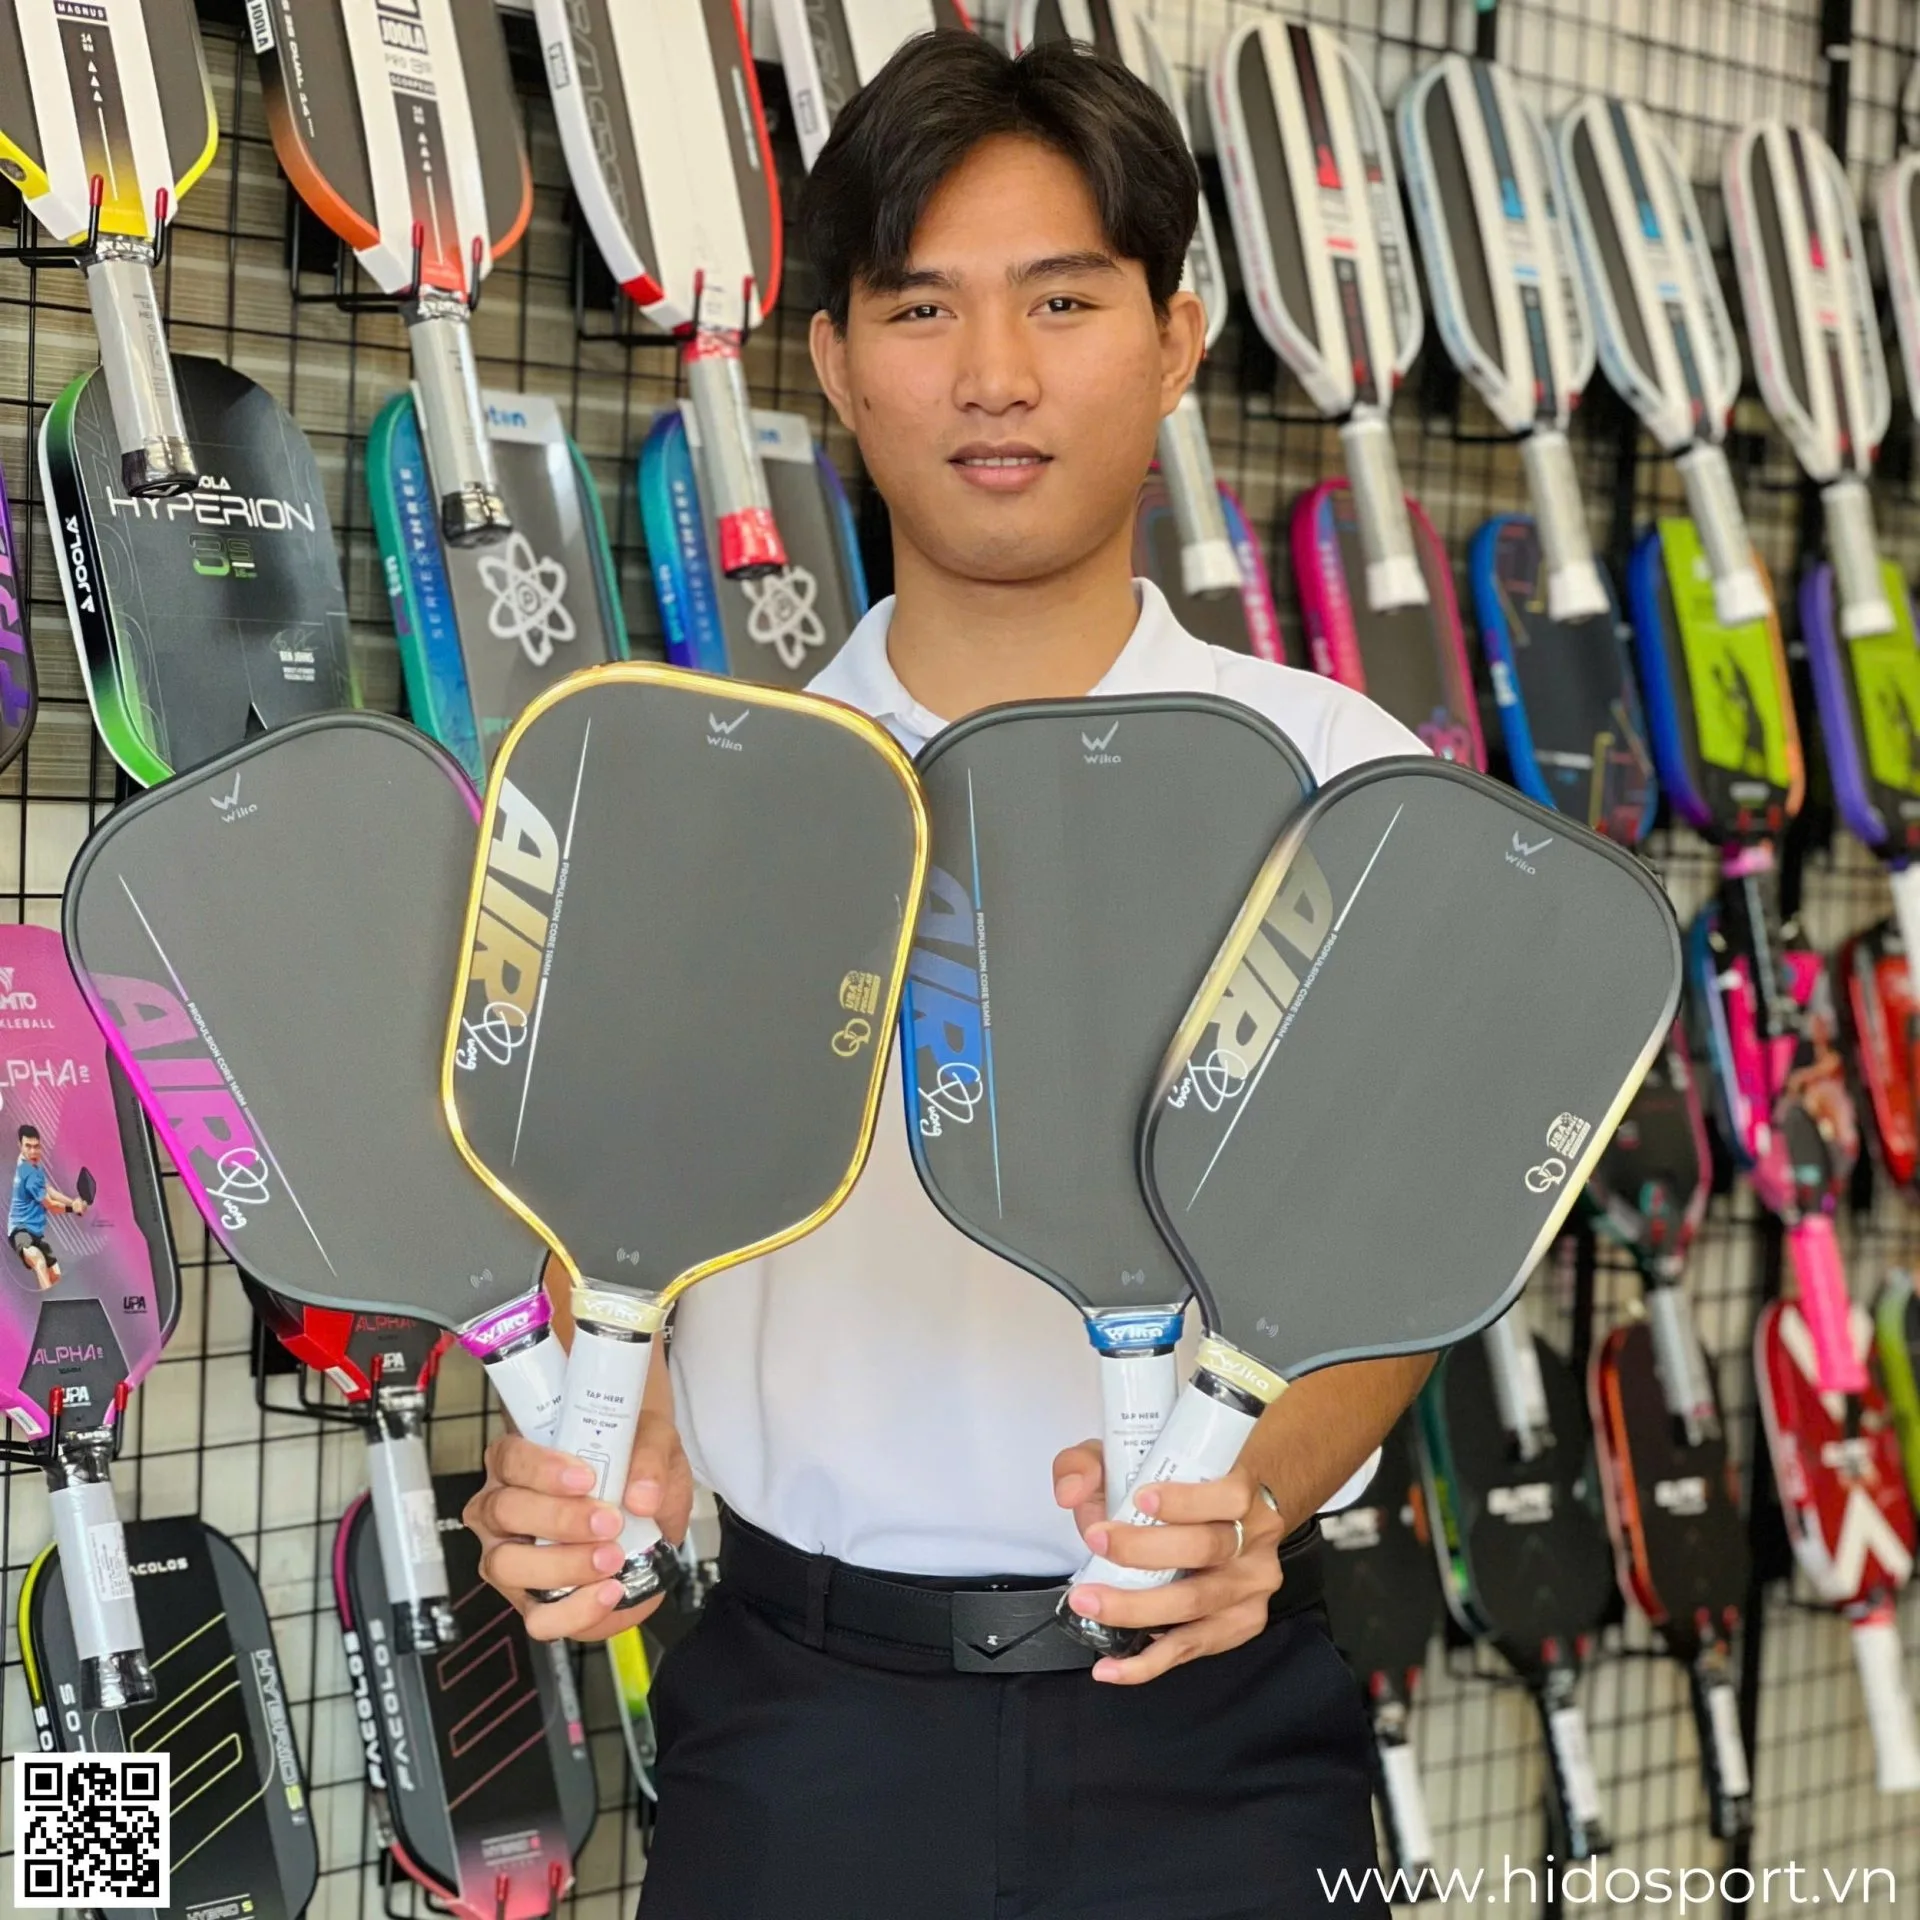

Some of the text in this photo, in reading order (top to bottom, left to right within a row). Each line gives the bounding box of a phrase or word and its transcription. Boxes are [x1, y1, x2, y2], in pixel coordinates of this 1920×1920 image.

[57, 3, 104, 18] MAGNUS
[251, 3, 269, 48] JOOLA
[199, 475, 231, 490] OLA
[106, 486, 316, 532] HYPERION
[65, 515, 91, 593] JOOLA
[470, 777, 560, 1028] AIR
[551, 862, 570, 924] PROPULSION
[548, 922, 560, 949] CORE
[976, 912, 988, 973] PROPULSION
[909, 865, 983, 1085] AIR
[1208, 843, 1334, 1079] AIR
[1302, 933, 1338, 990] PROPULSION
[0, 992, 36, 1010] MITO
[979, 973, 990, 1000] CORE
[1291, 987, 1309, 1014] CORE
[0, 1018, 55, 1029] KLEBALL
[90, 972, 257, 1168] AIR
[187, 1002, 247, 1107] PROPULSION CORE 16MM
[123, 1296, 147, 1310] UPA
[355, 1316, 410, 1332] ALPHA
[32, 1344, 97, 1365] ALPHA
[382, 1352, 405, 1368] PA
[586, 1389, 625, 1404] TAP HERE
[1121, 1412, 1159, 1420] TAP HERE
[127, 1557, 189, 1575] ACOLOS
[253, 1648, 298, 1786] HYBRID
[343, 1631, 387, 1790] FACOLOS
[368, 1619, 416, 1792] FACOLOS
